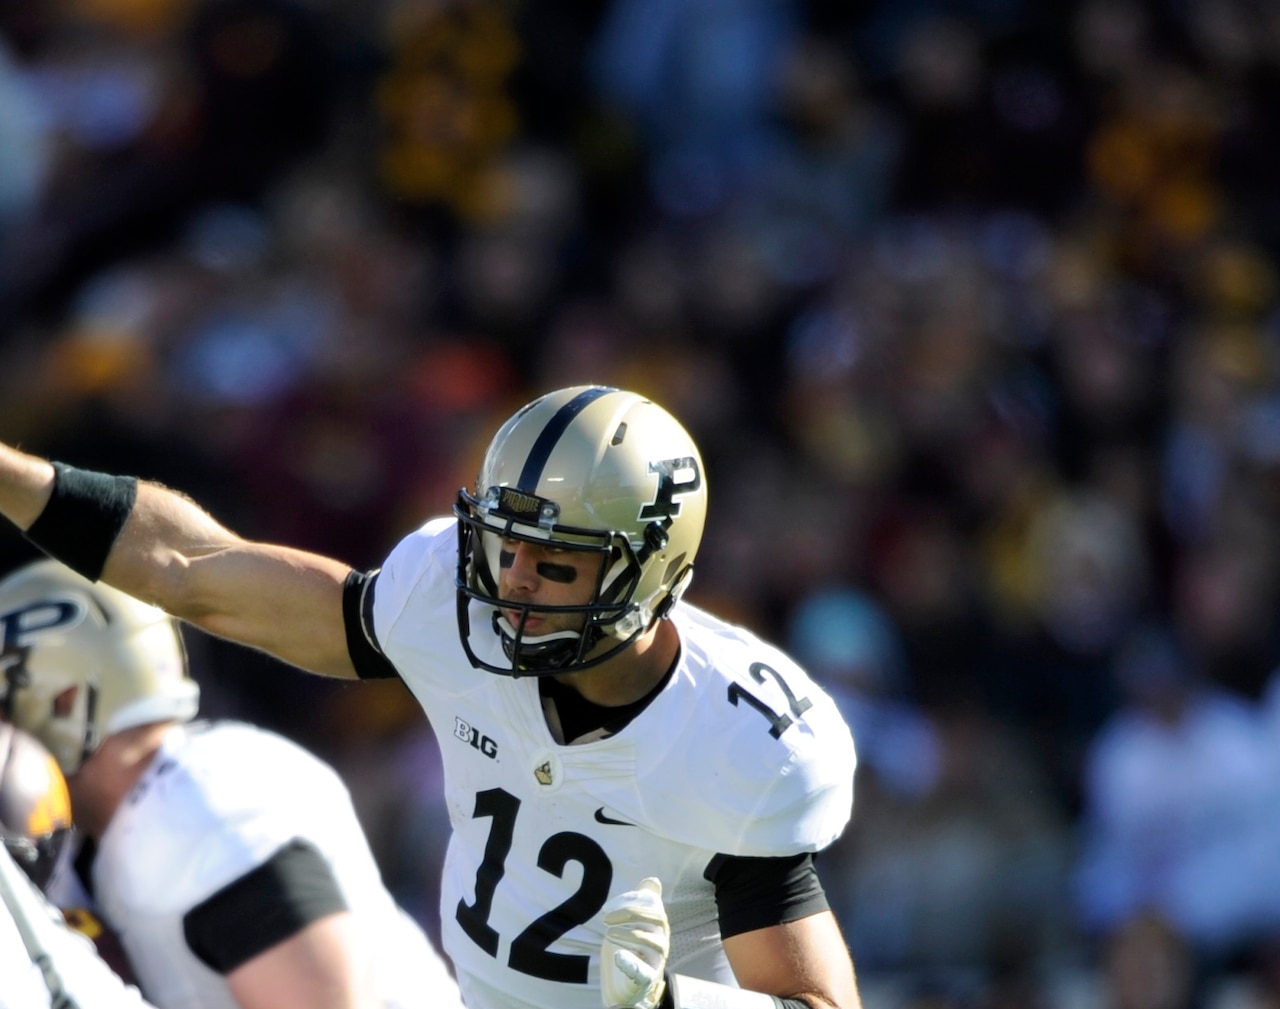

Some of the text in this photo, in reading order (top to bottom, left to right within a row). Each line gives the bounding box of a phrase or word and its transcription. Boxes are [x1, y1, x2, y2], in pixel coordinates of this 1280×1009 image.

[502, 489, 541, 513] PURDUE
[637, 455, 702, 520] P
[727, 662, 814, 741] 12
[455, 787, 614, 985] 12
